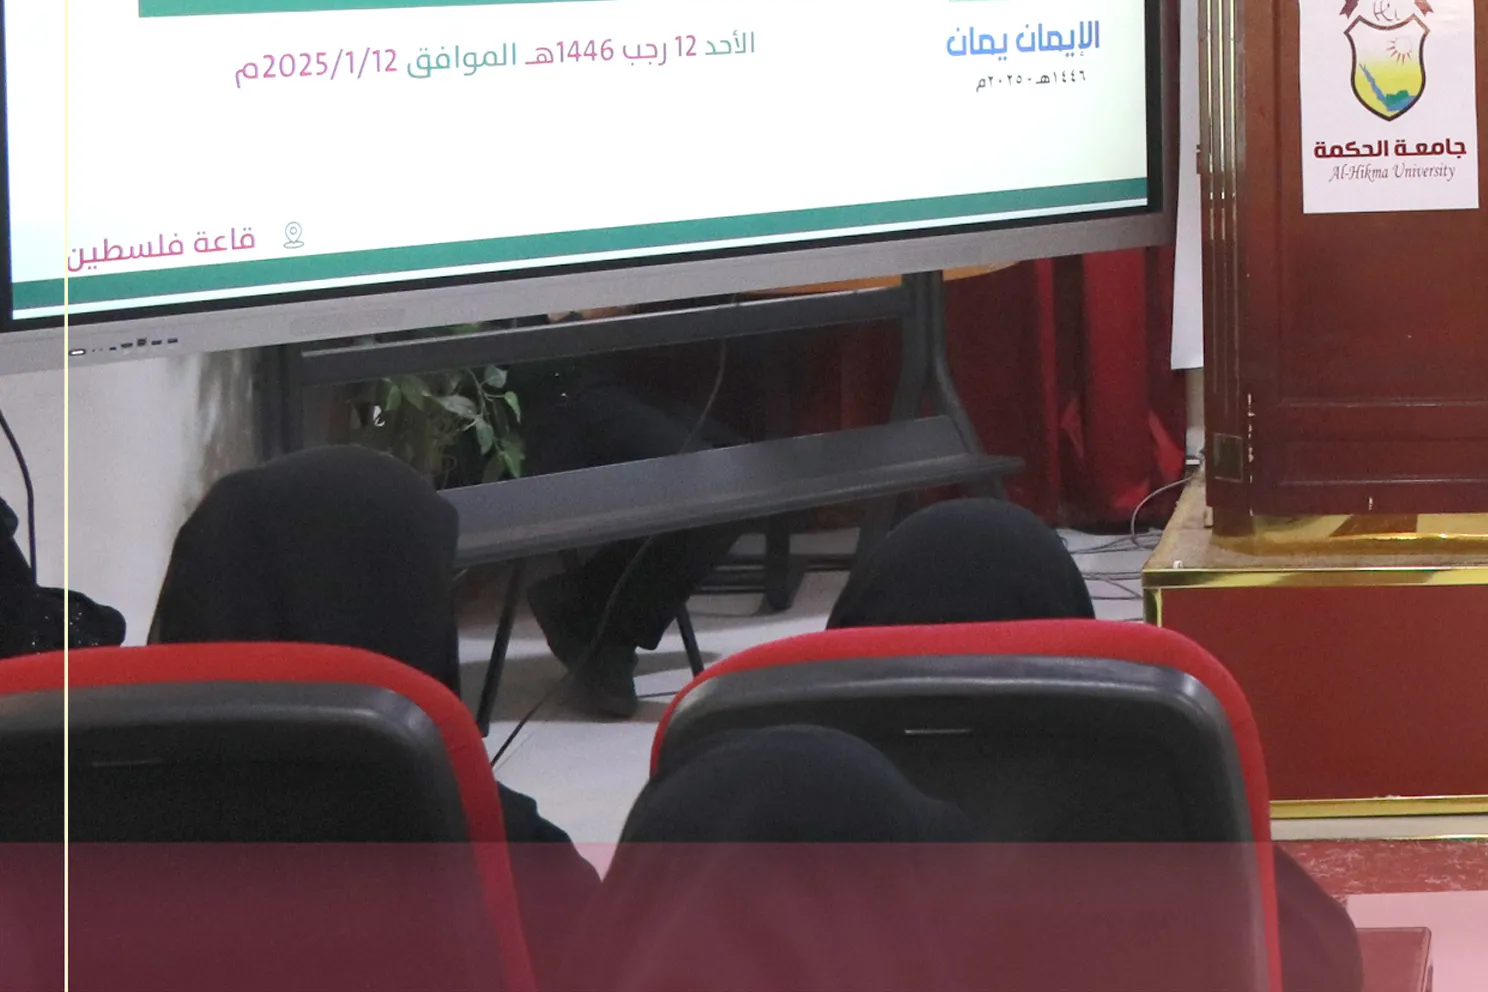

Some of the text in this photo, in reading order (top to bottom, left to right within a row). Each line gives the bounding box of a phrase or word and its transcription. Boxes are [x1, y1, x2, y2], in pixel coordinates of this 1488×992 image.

[622, 37, 669, 66] رجب
[673, 34, 698, 58] 12
[704, 30, 757, 58] الأحد
[946, 20, 1101, 62] الإيمان يمان
[405, 42, 518, 81] الموافق
[1313, 138, 1467, 159] جامعة الحكمة
[1328, 163, 1456, 183] Al-Hikma University
[66, 227, 256, 272] قاعة فلسطين
